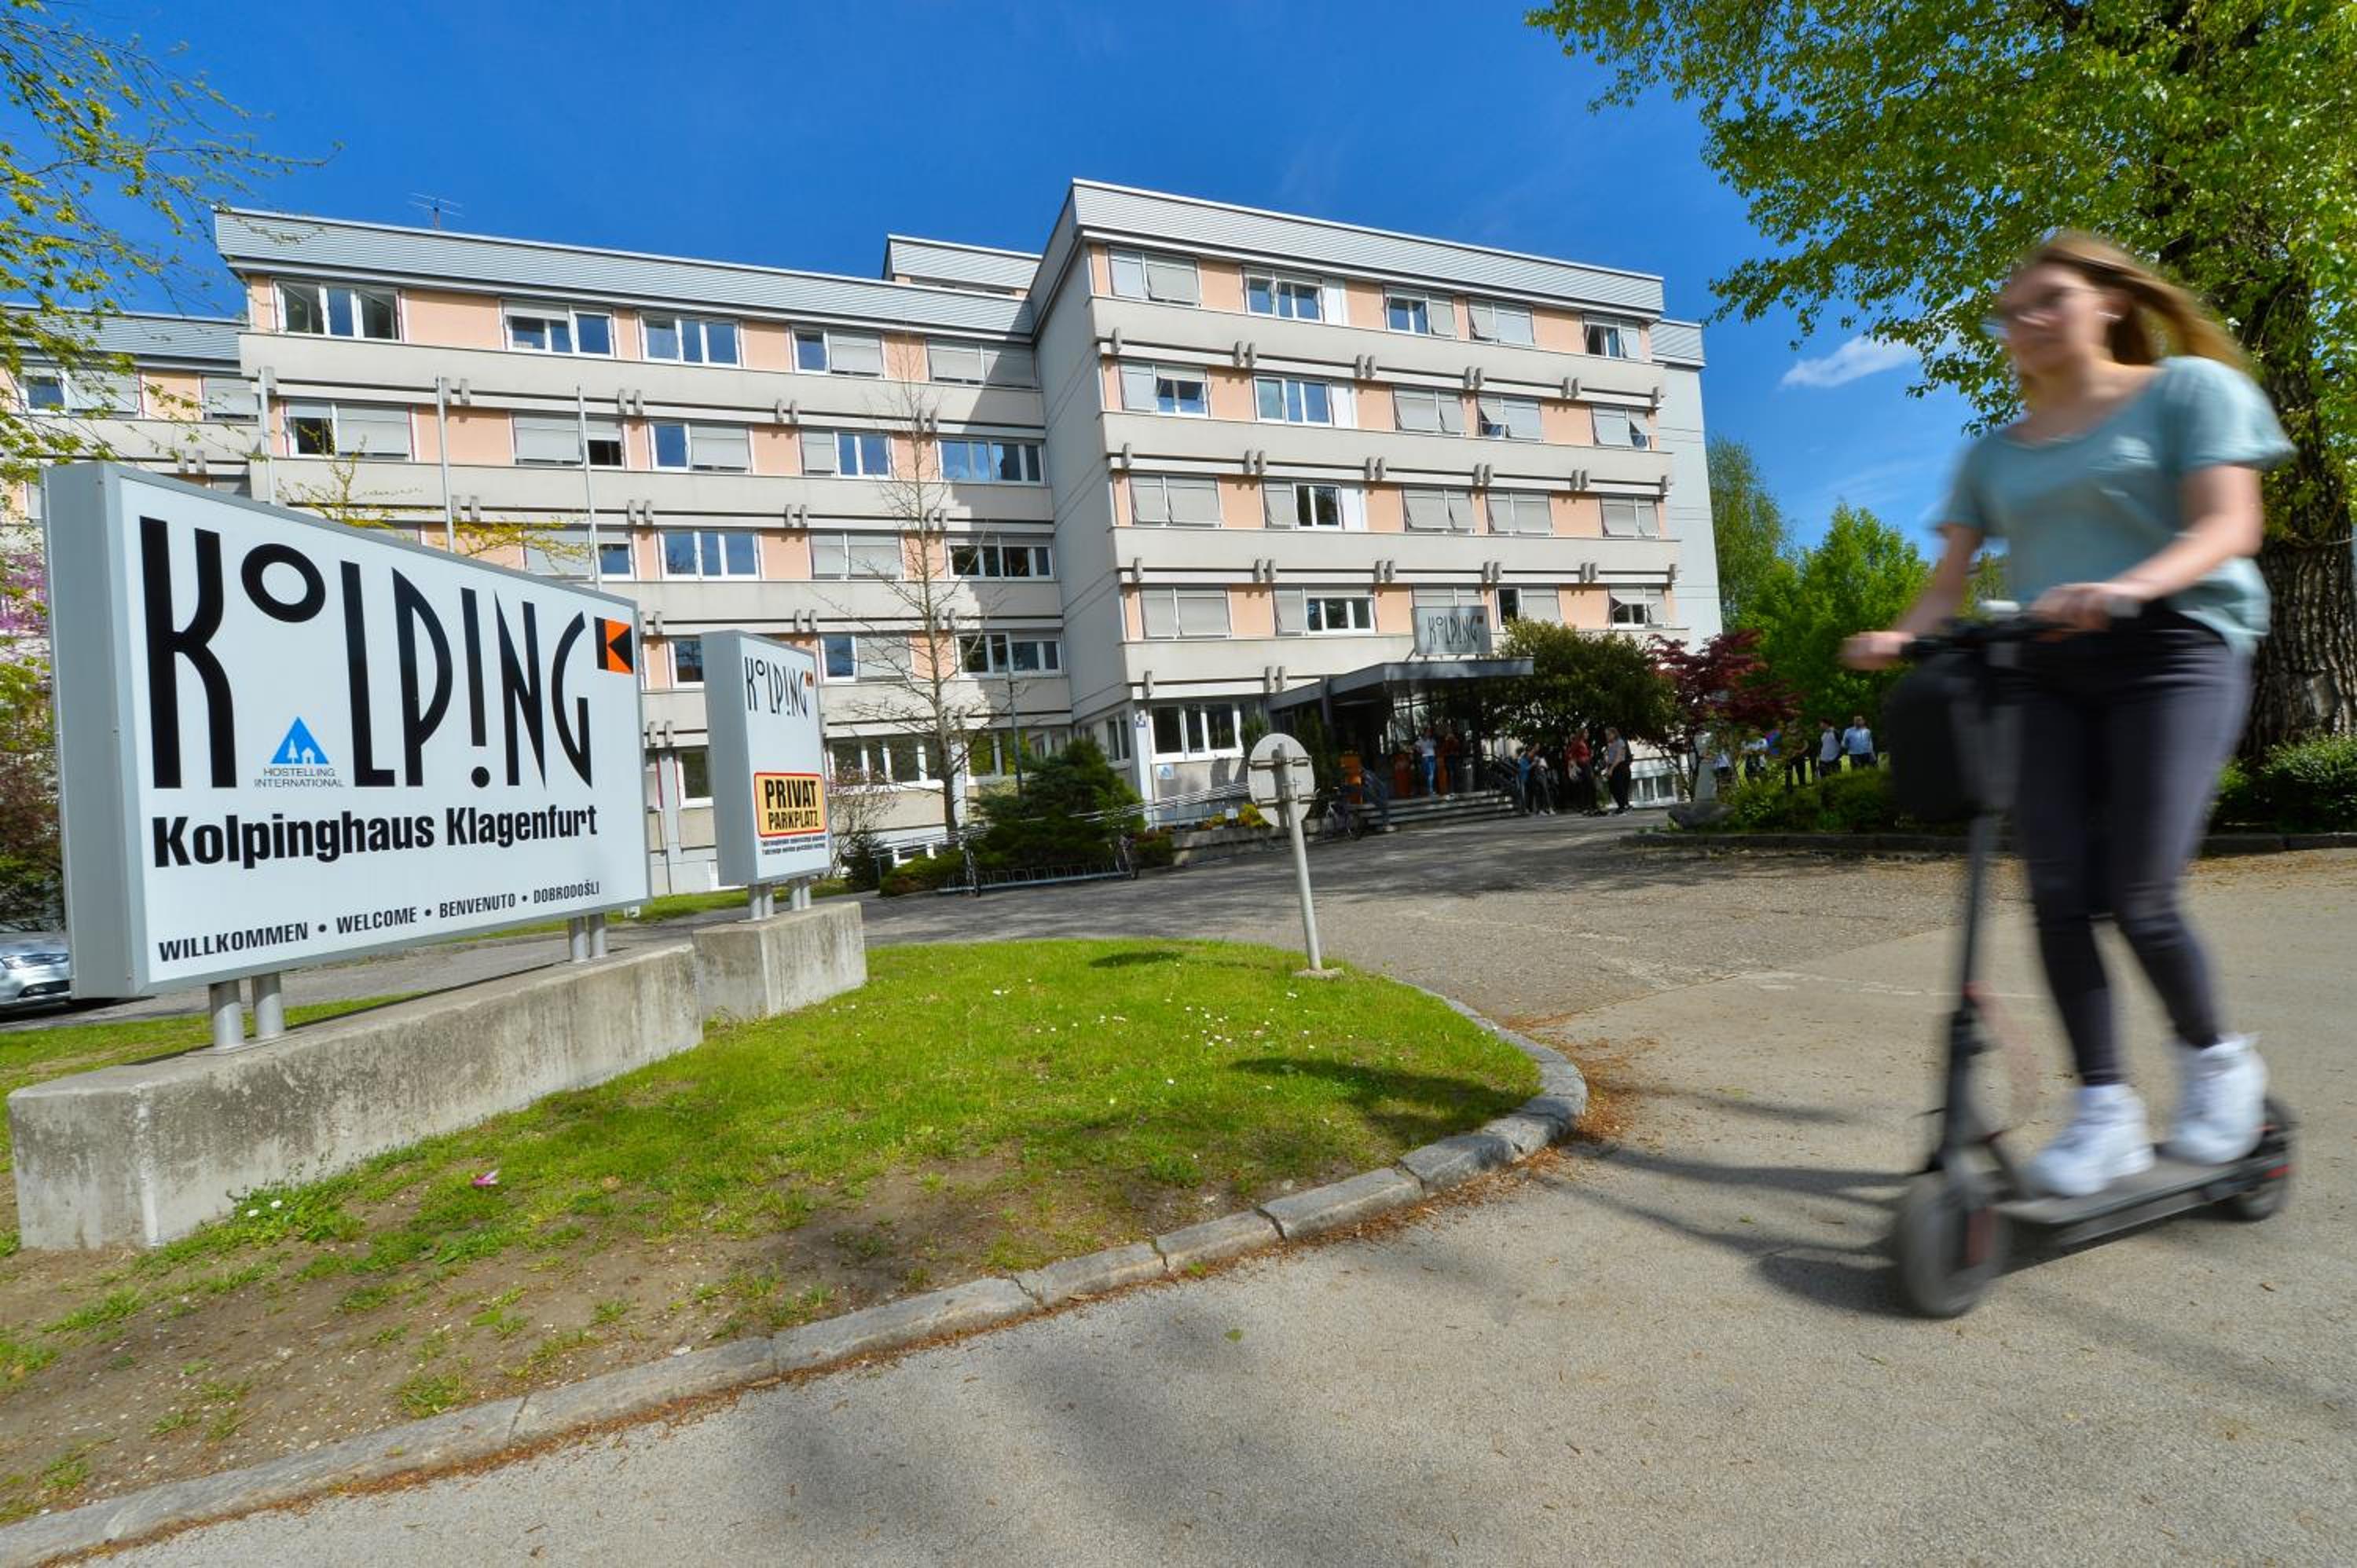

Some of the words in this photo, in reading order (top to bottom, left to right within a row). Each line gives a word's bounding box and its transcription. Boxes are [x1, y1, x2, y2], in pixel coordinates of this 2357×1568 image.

[254, 779, 344, 788] INTERNATIONAL
[263, 768, 335, 777] HOSTELLING
[764, 779, 816, 809] PRIVAT
[768, 811, 819, 830] PARKPLATZ
[152, 811, 435, 869] Kolpinghaus
[445, 804, 598, 848] Klagenfurt
[158, 921, 308, 962] WILLKOMMEN
[335, 907, 417, 934] WELCOME
[439, 892, 516, 918] BENVENUTO
[533, 880, 600, 904] DOBRODOŠLI
